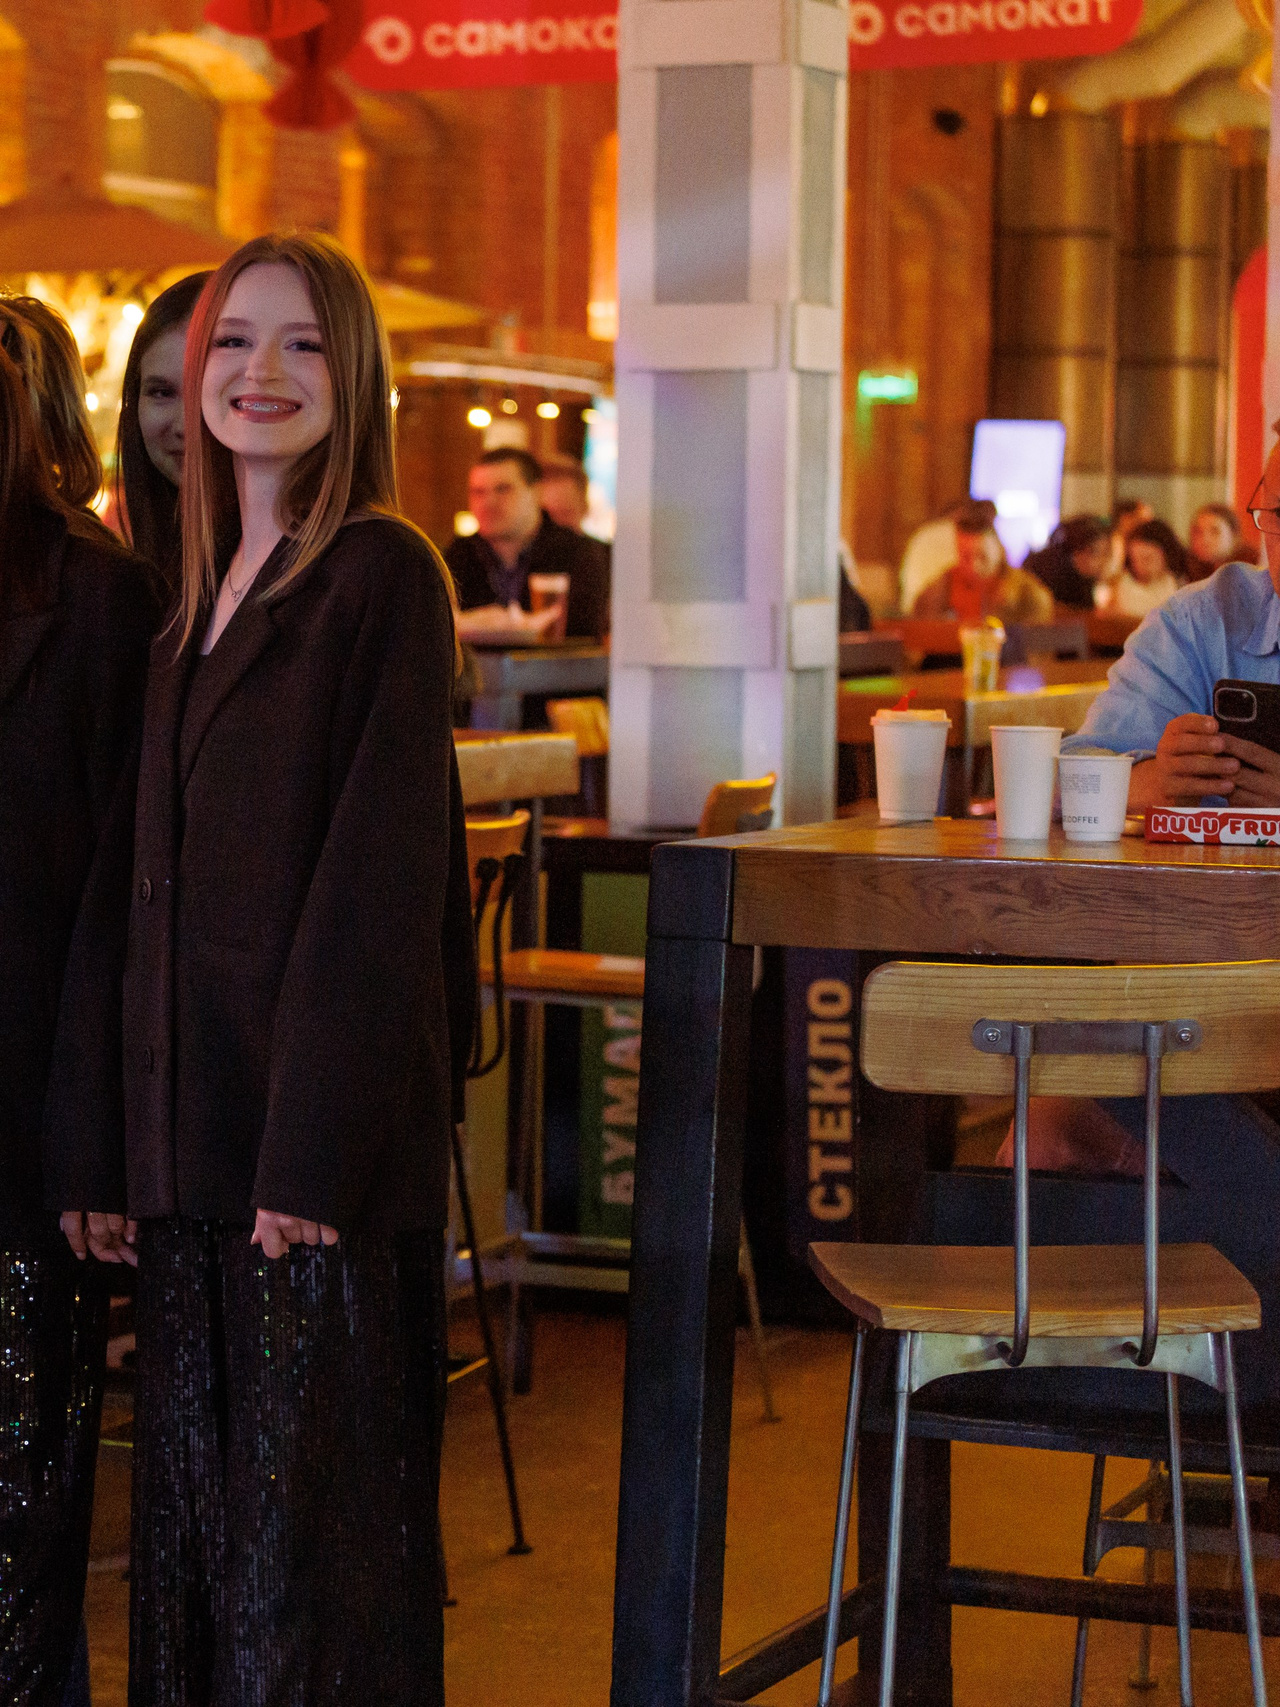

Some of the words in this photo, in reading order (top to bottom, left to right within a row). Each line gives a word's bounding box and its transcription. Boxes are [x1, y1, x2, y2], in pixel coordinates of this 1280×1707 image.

[423, 14, 618, 58] самока
[1152, 814, 1219, 836] HULU
[1228, 819, 1280, 837] FRU
[601, 1002, 644, 1205] БУМАГ
[807, 978, 853, 1221] СТЕКЛО
